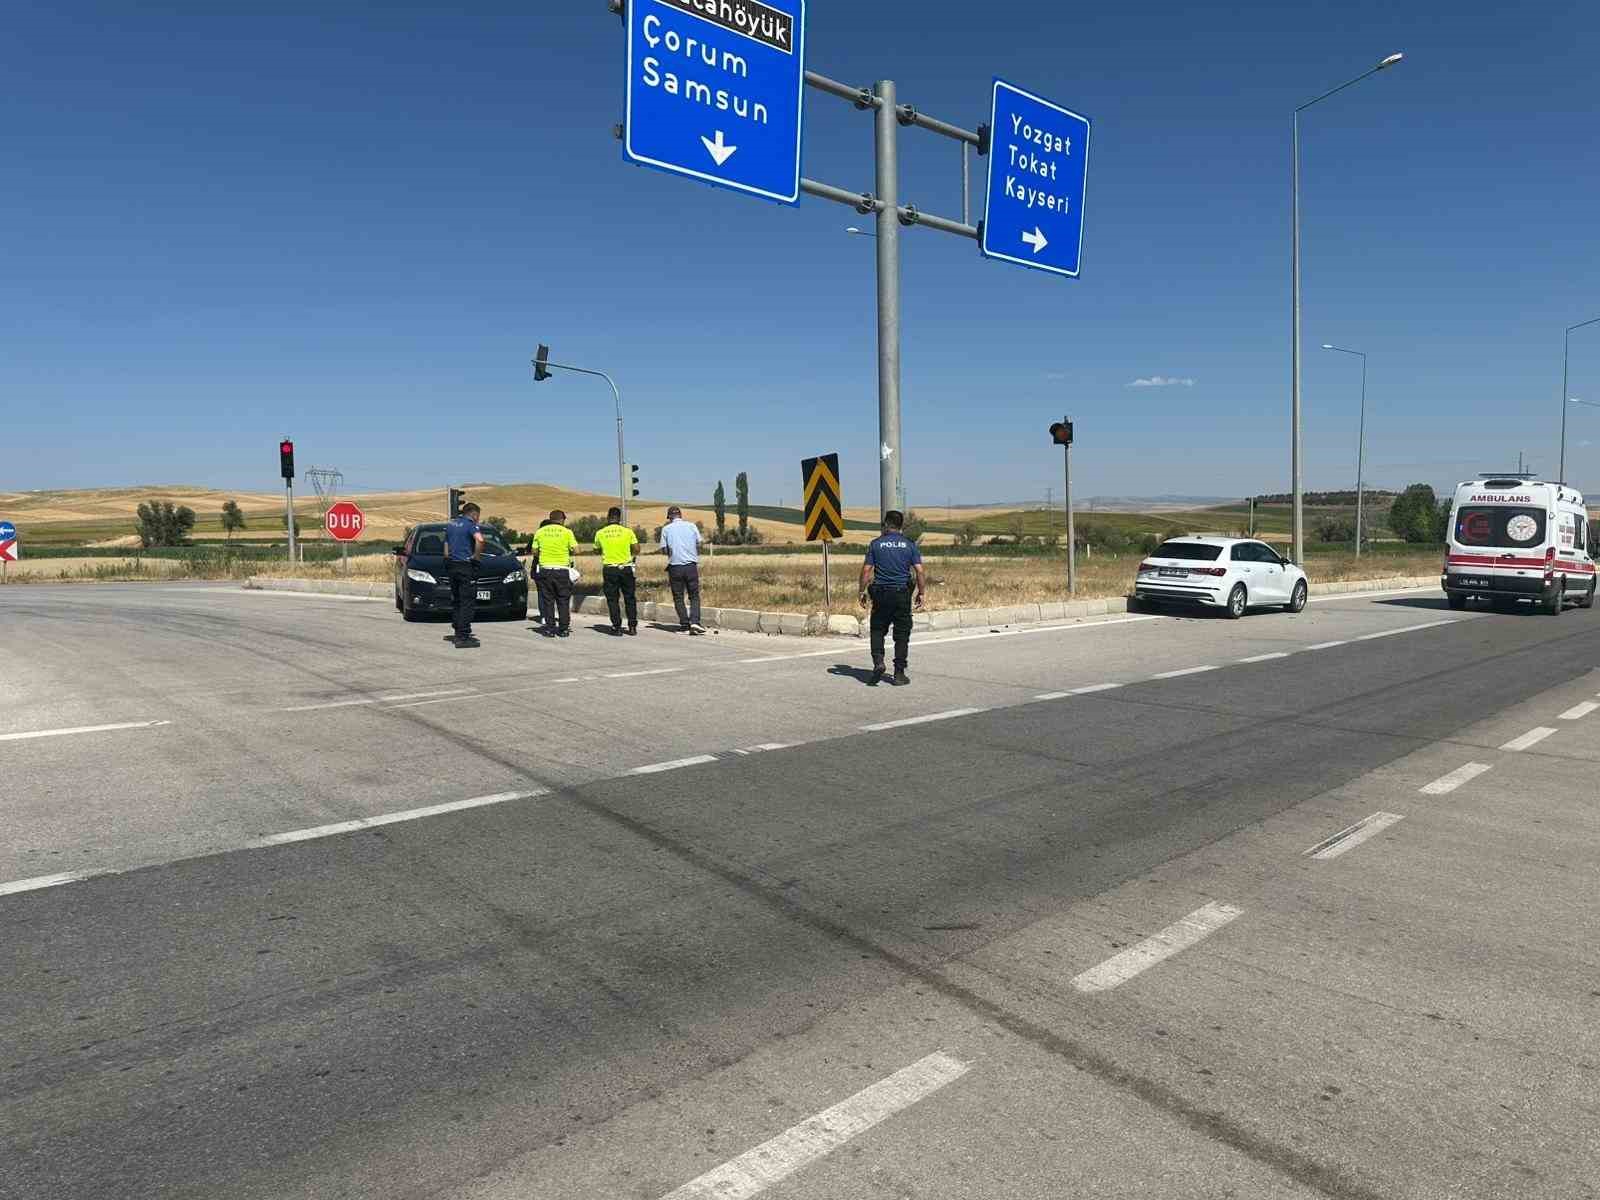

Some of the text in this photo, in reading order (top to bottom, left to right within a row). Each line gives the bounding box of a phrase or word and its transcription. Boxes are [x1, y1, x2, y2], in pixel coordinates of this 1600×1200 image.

[643, 15, 747, 77] Çorum
[643, 57, 768, 124] Samsun
[1011, 113, 1071, 156] Yozgat
[1009, 144, 1057, 180] Tokat
[1005, 175, 1069, 214] Kayseri
[1470, 495, 1531, 503] AMBULANS
[329, 513, 361, 529] DUR
